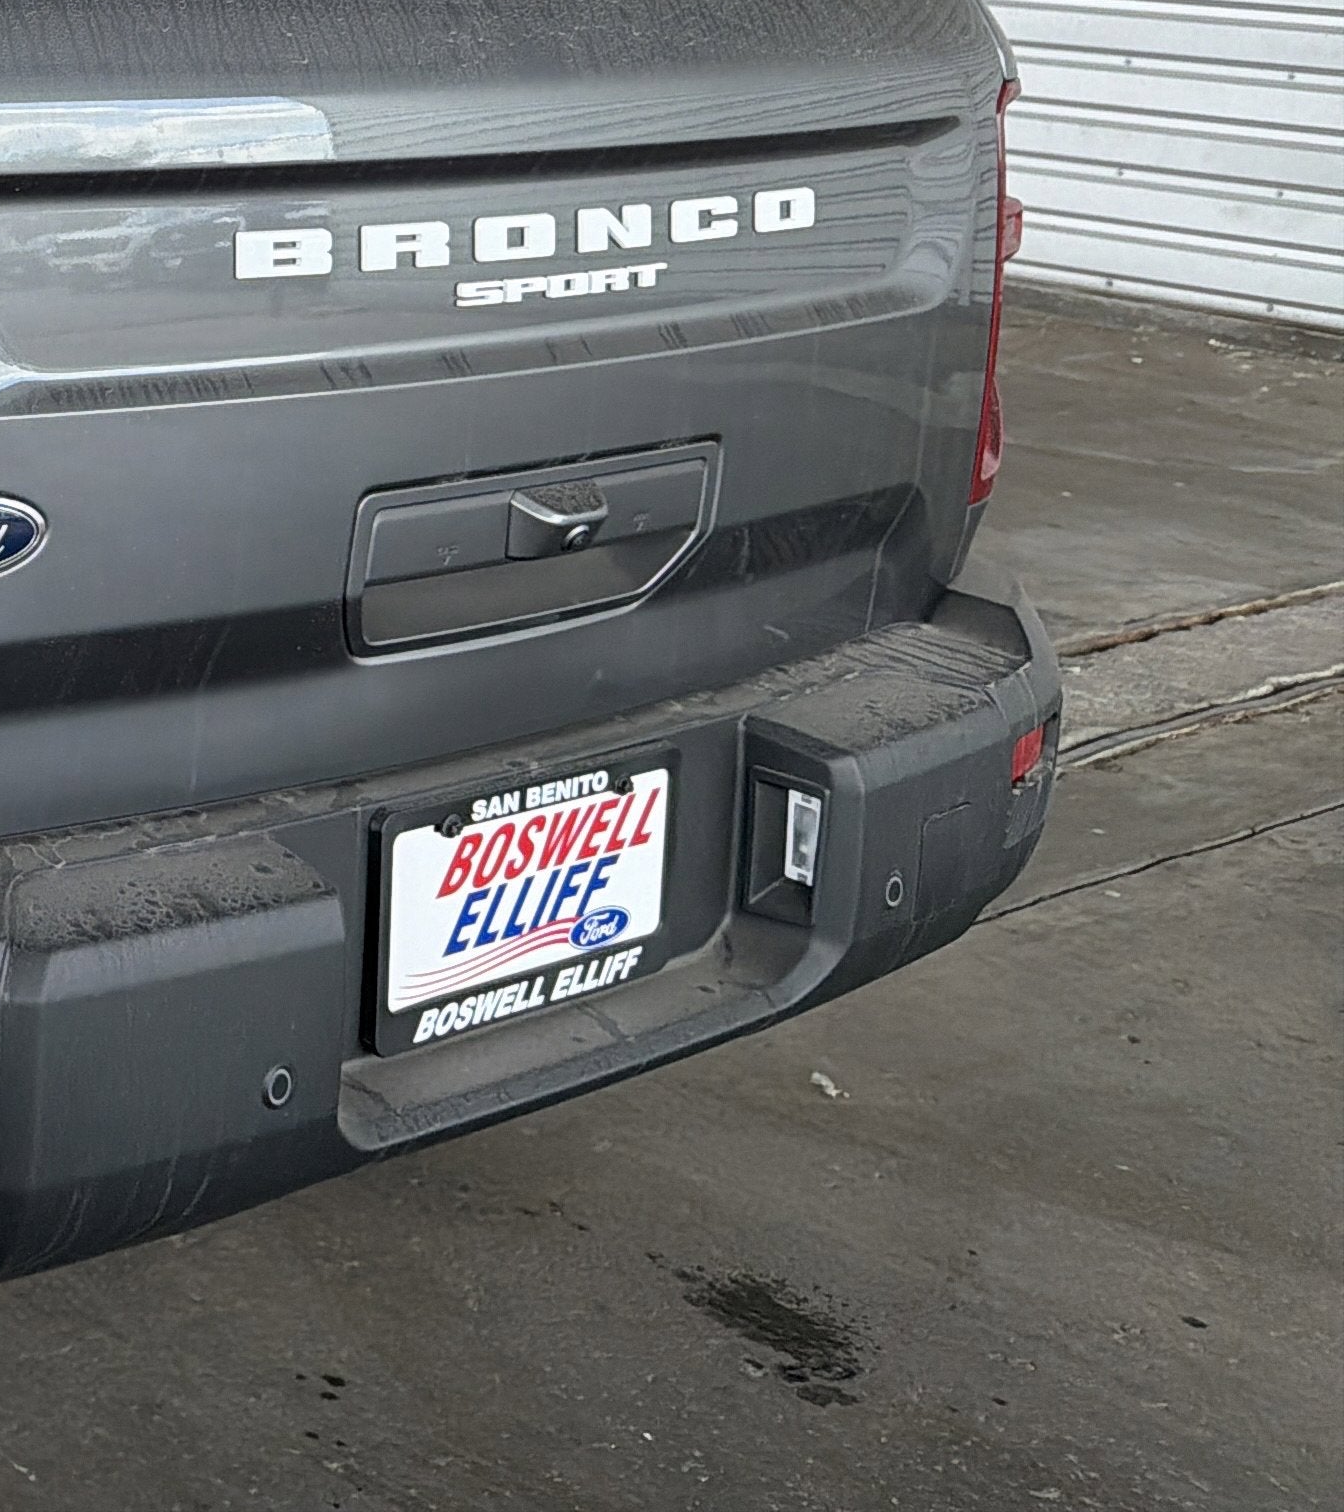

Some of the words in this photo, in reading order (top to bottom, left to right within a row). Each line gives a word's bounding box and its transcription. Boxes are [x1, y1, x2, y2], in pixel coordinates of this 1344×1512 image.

[233, 186, 816, 280] BRONCO
[454, 261, 668, 308] SPORT
[435, 786, 661, 899] BOSWELL
[470, 790, 521, 822] SAN
[525, 770, 609, 808] BENITO
[442, 854, 620, 958] ELLIFF
[579, 914, 619, 945] Ford
[412, 976, 546, 1044] BOSWELL
[550, 946, 643, 1002] ELLIFF
